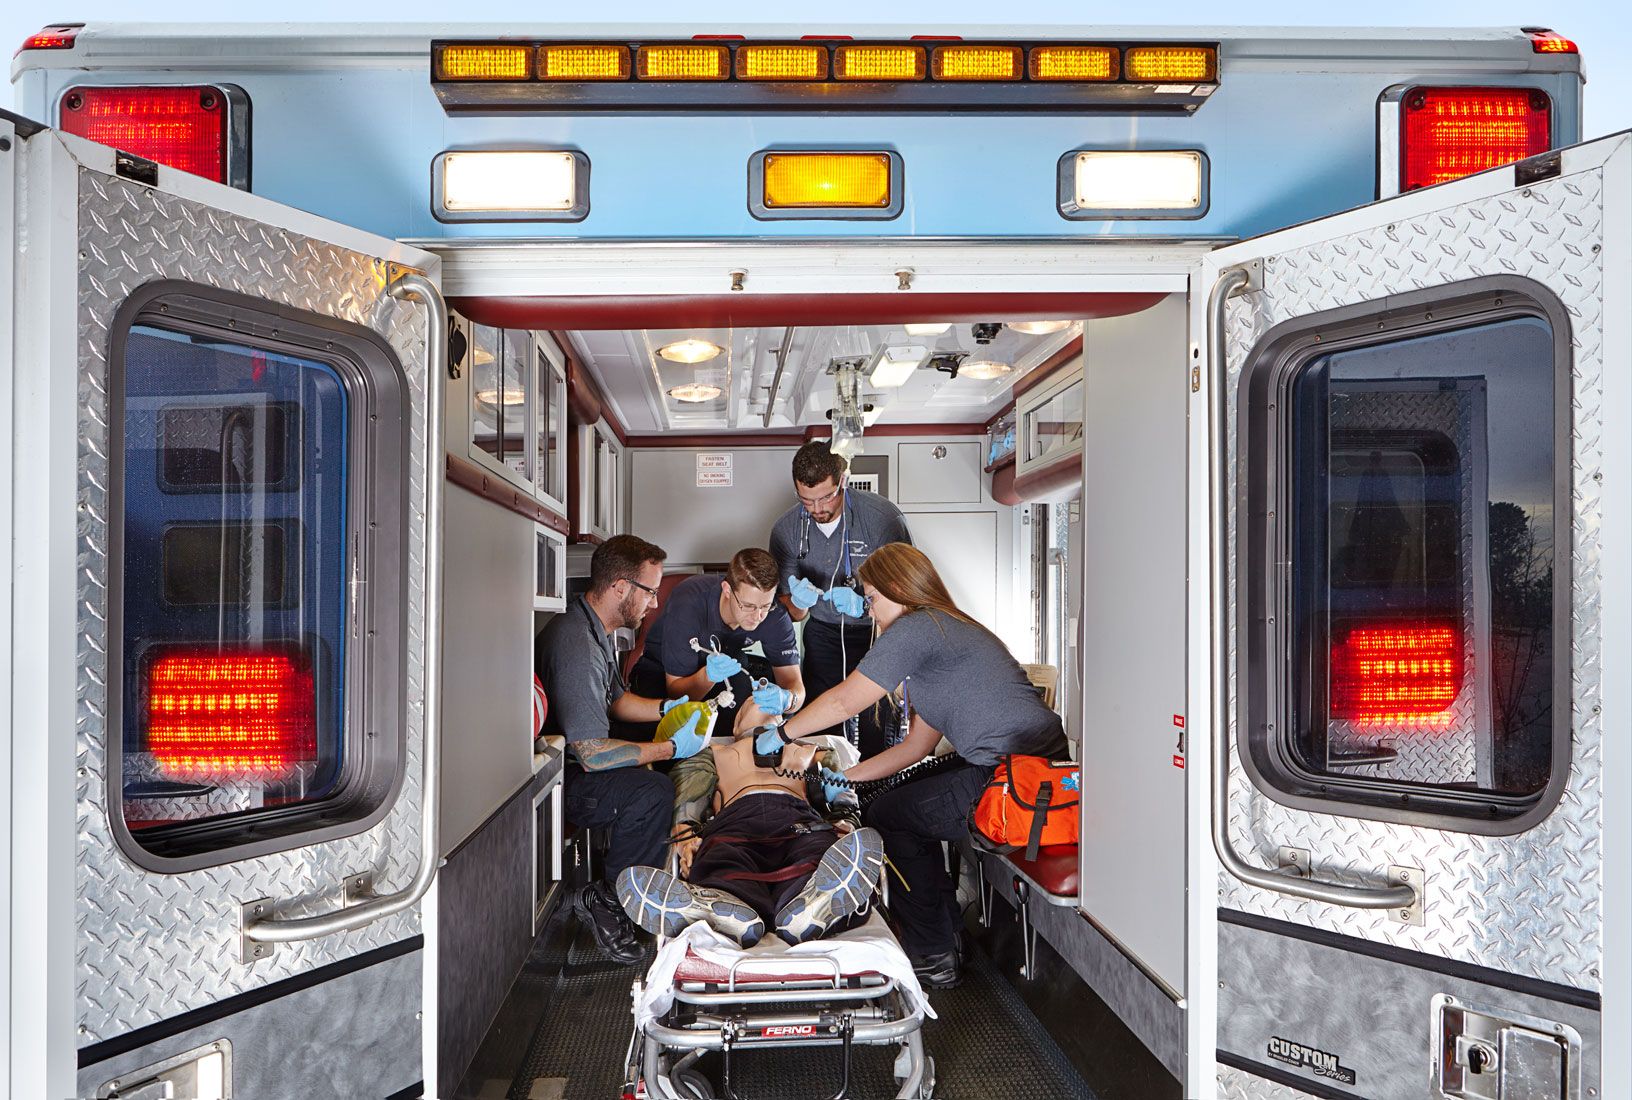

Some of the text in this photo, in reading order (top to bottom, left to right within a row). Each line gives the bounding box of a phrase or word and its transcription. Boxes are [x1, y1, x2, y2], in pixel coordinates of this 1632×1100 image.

[766, 1025, 812, 1036] FERNO
[1269, 1037, 1337, 1072] CUSTOM
[1314, 1064, 1351, 1082] Series
